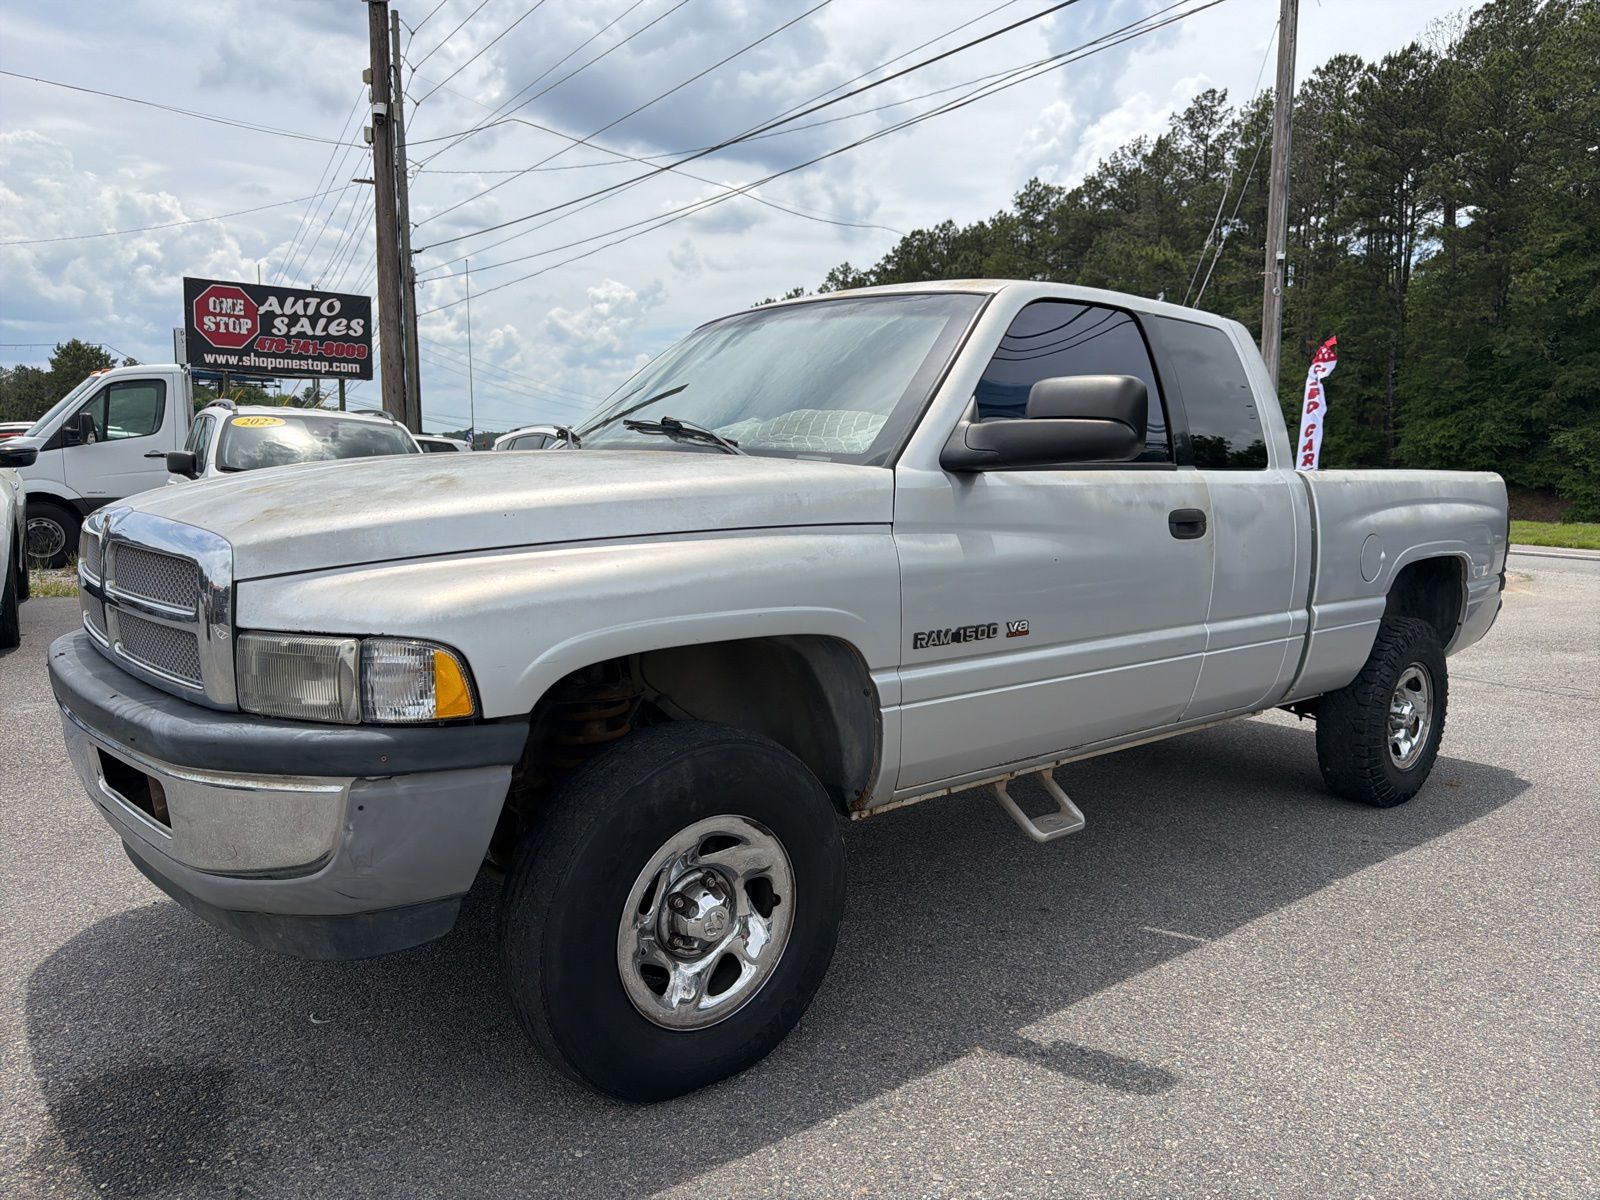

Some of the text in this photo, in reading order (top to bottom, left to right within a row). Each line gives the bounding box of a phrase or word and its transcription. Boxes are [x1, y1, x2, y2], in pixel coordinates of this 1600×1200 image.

[209, 296, 245, 315] ONE
[257, 295, 342, 317] AUTO
[203, 315, 252, 335] STOP
[203, 352, 361, 374] www.shoponestop.com
[1300, 423, 1317, 470] CAR
[912, 628, 952, 649] RAM
[954, 622, 999, 644] 1500
[1006, 619, 1030, 634] V8
